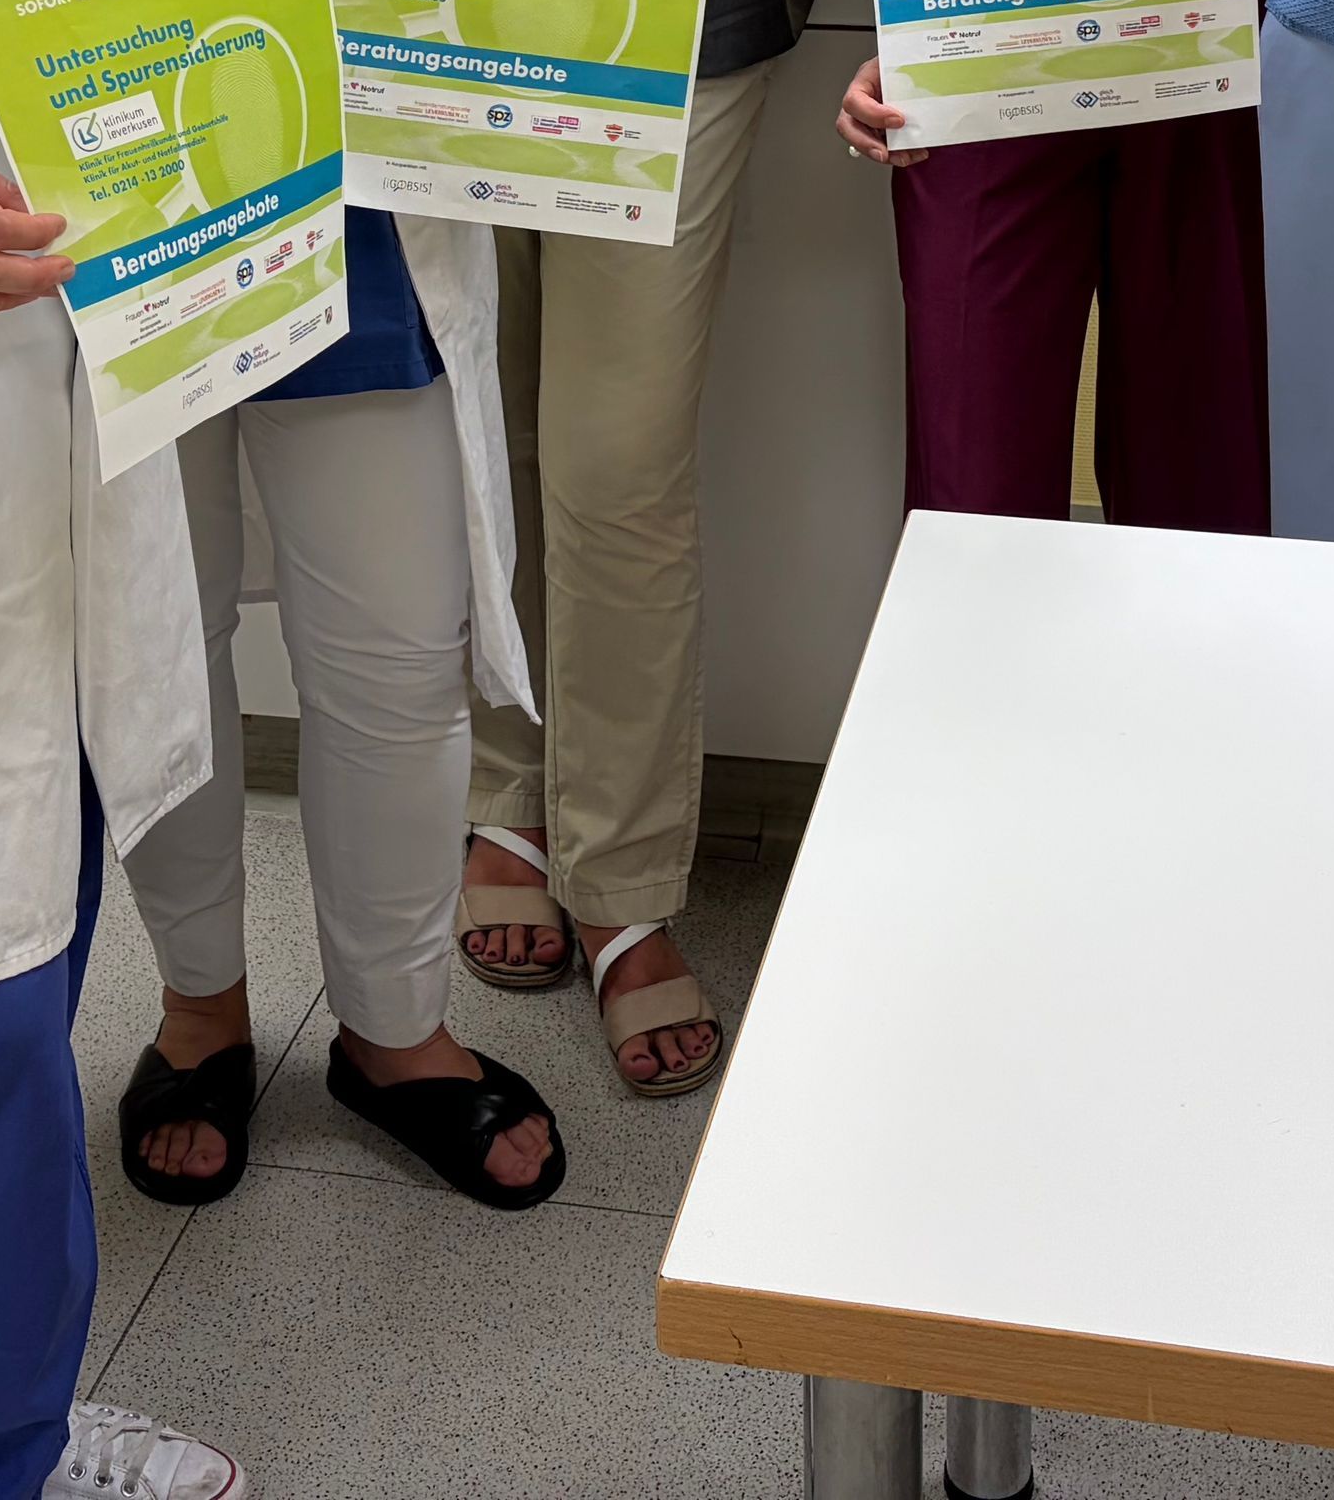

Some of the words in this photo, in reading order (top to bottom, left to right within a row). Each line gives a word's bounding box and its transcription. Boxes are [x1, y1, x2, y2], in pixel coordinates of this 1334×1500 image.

[1077, 25, 1098, 35] spz
[35, 17, 195, 78] Untersuchung
[49, 79, 98, 109] und
[102, 28, 266, 96] Spurensicherung
[361, 84, 385, 94] Notruf
[103, 108, 144, 127] klinikum
[107, 116, 158, 140] leverkusen
[487, 109, 511, 124] spz
[79, 156, 103, 172] Klinik
[104, 154, 115, 165] für
[84, 168, 107, 184] Klinik
[108, 166, 119, 177] für
[143, 152, 157, 165] und
[89, 186, 111, 201] Tel.
[112, 176, 139, 194] 0214
[161, 159, 185, 177] 2000
[111, 191, 279, 281] Beratungsangebote
[237, 264, 253, 282] spz
[126, 310, 144, 322] Frauen
[152, 296, 169, 310] Notruf
